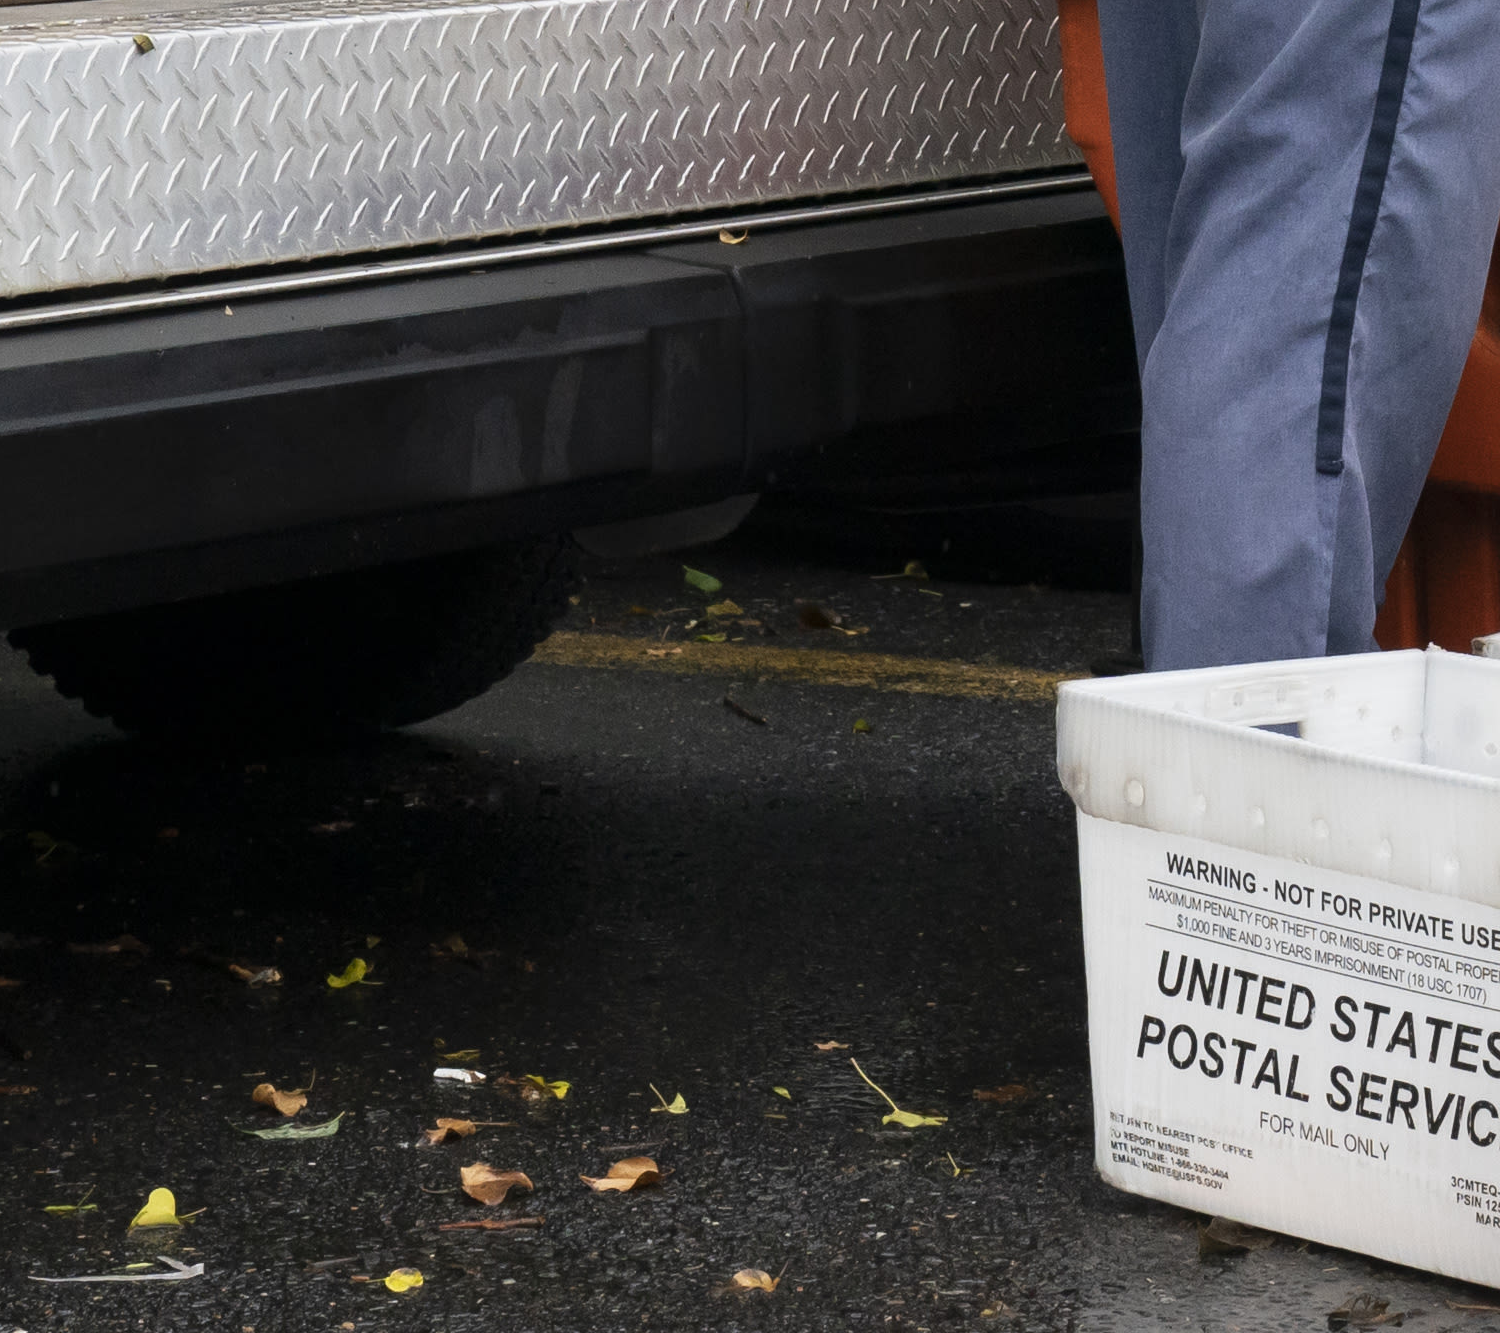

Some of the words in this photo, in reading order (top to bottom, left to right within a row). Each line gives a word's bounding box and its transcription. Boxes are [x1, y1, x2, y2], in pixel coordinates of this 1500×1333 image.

[1148, 885, 1201, 912] MAXIMUM
[1204, 900, 1253, 923] PENALTY
[1255, 914, 1278, 932] FOR
[1282, 920, 1317, 940] THEFT
[1320, 930, 1338, 946] OR
[1340, 935, 1384, 957] MISUSE
[1387, 946, 1403, 961] OF
[1407, 951, 1453, 973] POSTAL
[1166, 851, 1256, 894] WARNING
[1275, 879, 1314, 908] NOT
[1321, 891, 1362, 920] FOR
[1369, 902, 1453, 941] PRIVATE
[1158, 949, 1316, 1030] UNITED
[1177, 913, 1210, 934] $1,000
[1213, 923, 1236, 942] FINE
[1238, 929, 1262, 947] AND
[1264, 936, 1271, 950] 3
[1273, 940, 1312, 961] YEARS
[1315, 950, 1406, 983] IMPRISONMENT
[1407, 973, 1424, 988] (18
[1427, 977, 1453, 994] USC
[1456, 983, 1487, 1005] 1707)
[1137, 1014, 1309, 1103] POSTAL
[1123, 1131, 1156, 1149] REPORT
[1157, 1140, 1190, 1158] MISUSE
[1222, 1143, 1254, 1160] OFFICE
[1259, 1111, 1295, 1136] FOR
[1300, 1121, 1339, 1148] MAIL
[1344, 1133, 1389, 1162] ONLY
[1456, 1192, 1482, 1208] PSIN
[1475, 1212, 1500, 1228] MAR
